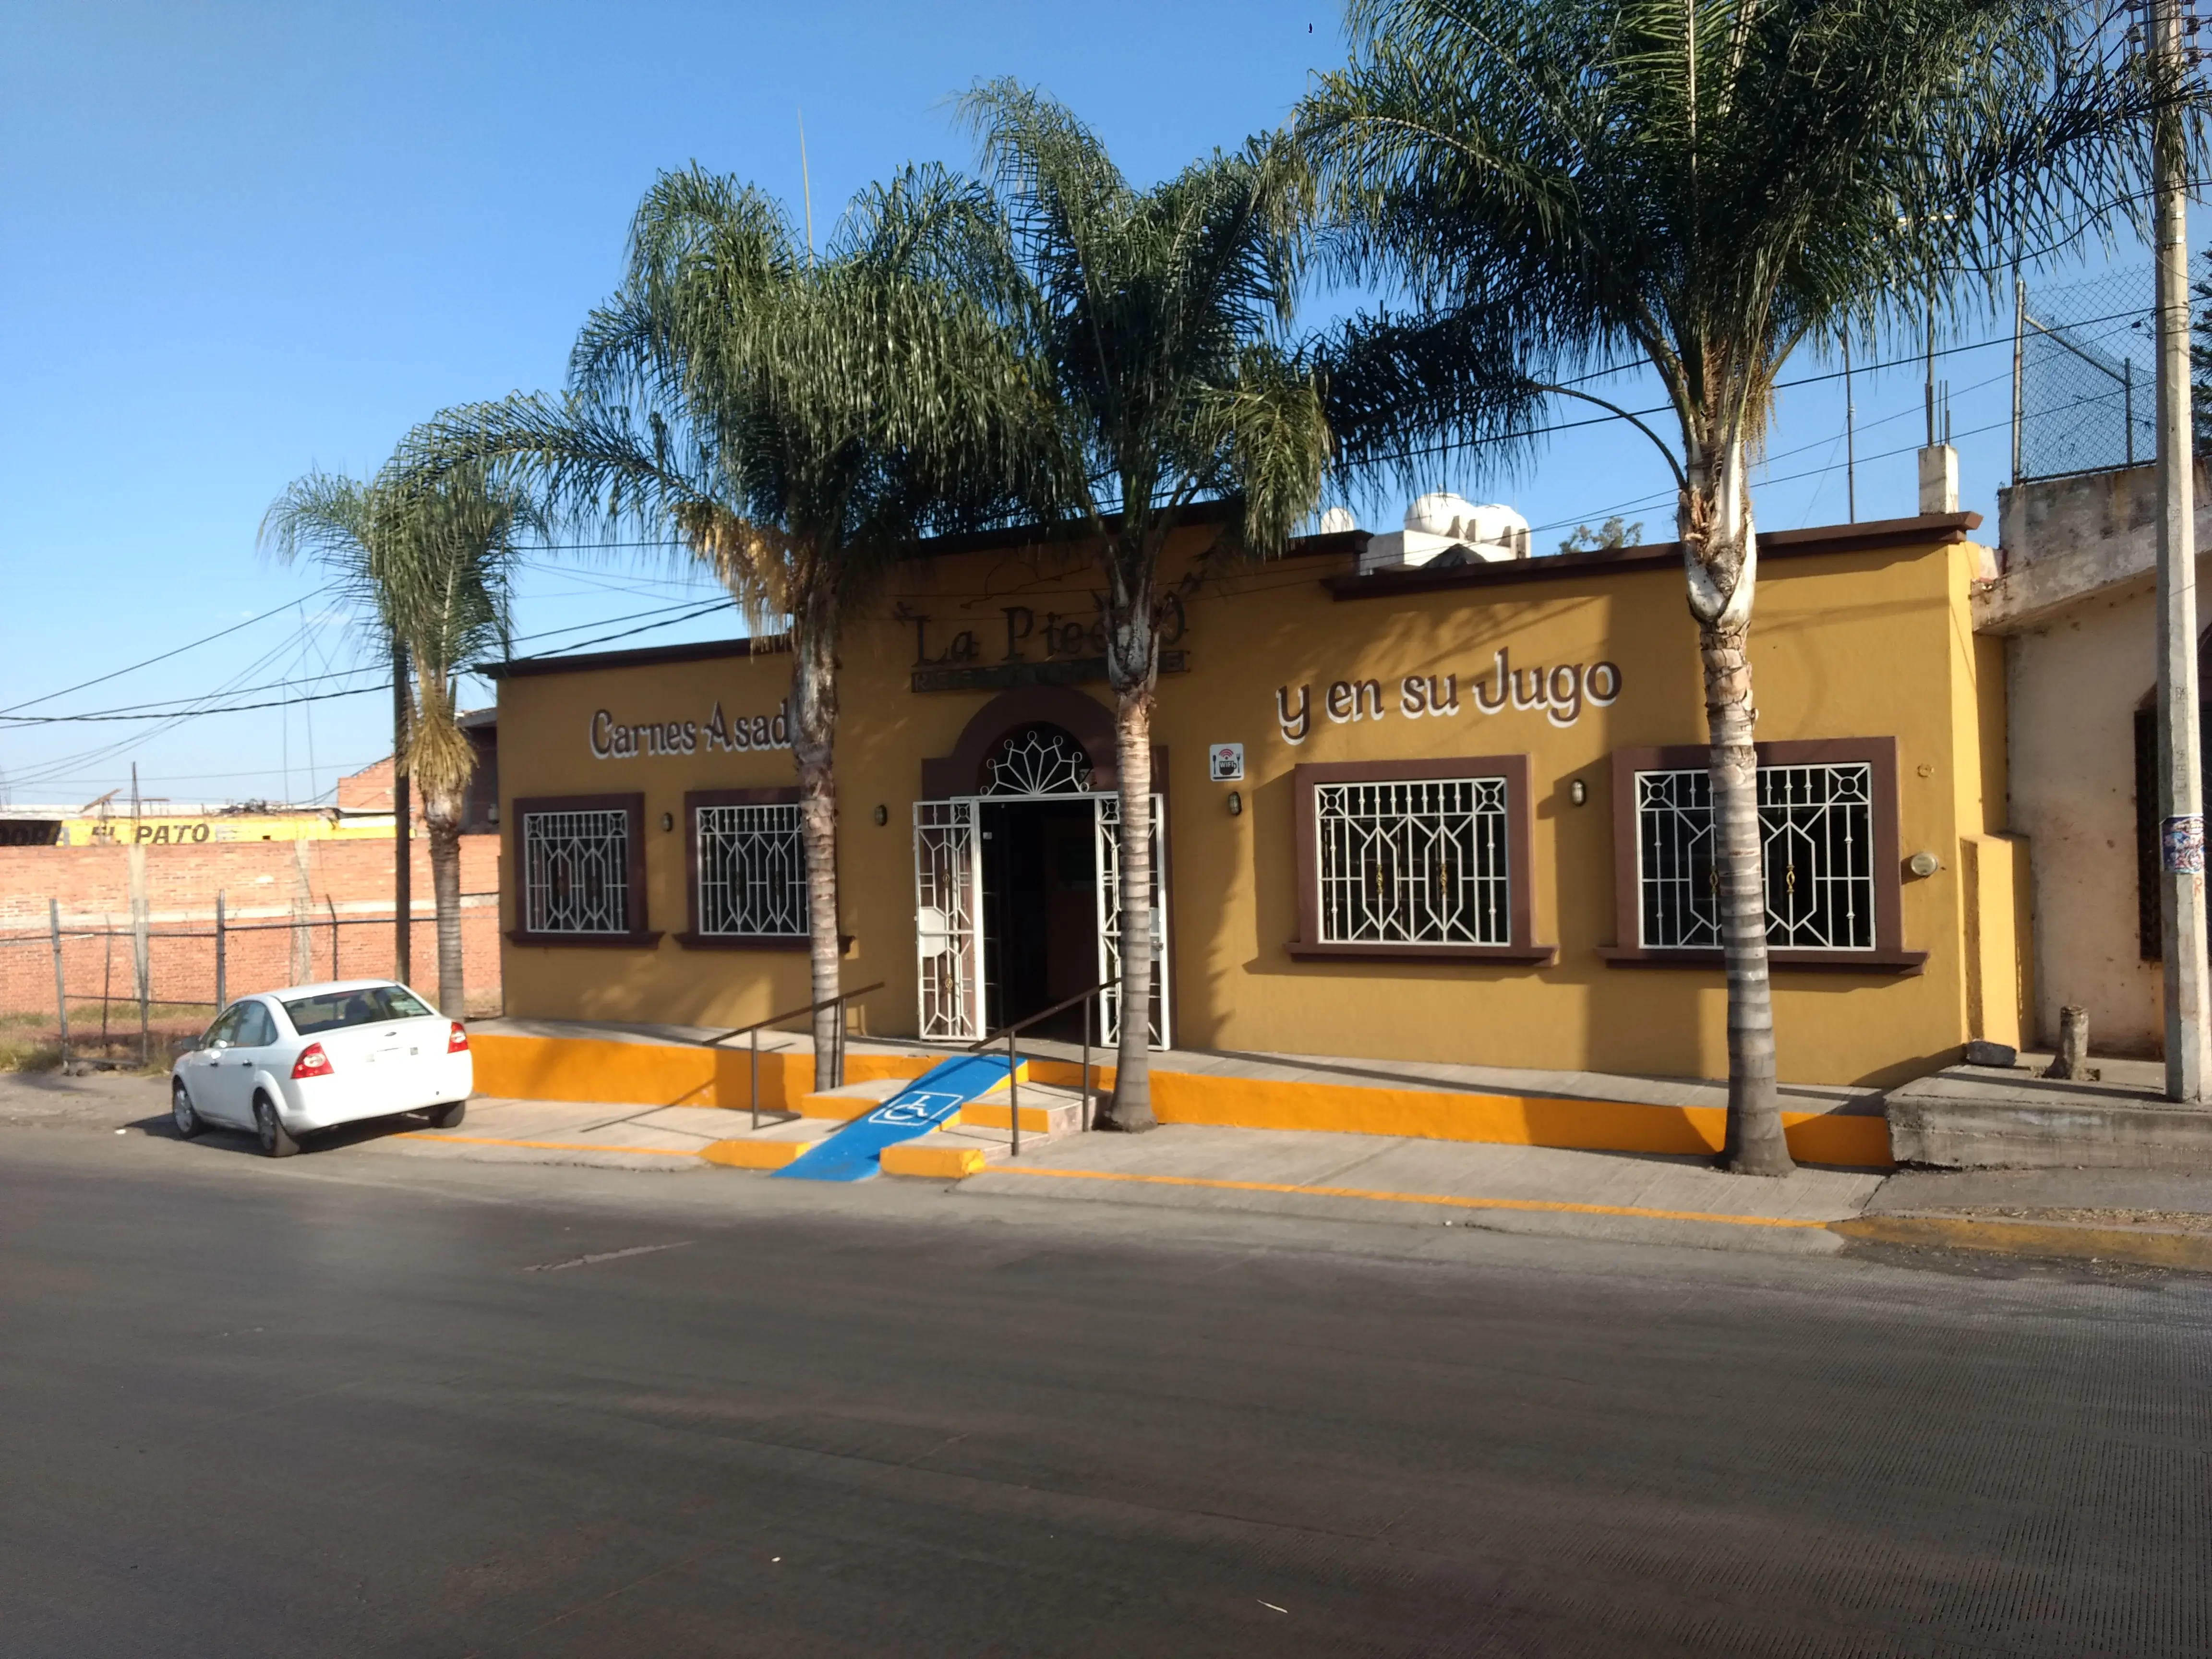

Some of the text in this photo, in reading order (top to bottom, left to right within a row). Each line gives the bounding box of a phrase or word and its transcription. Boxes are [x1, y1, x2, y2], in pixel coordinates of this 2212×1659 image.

[896, 602, 981, 668] La
[1276, 646, 1623, 745] y en su Jugo
[589, 698, 793, 760] Carnes Asad
[134, 823, 210, 845] PATO
